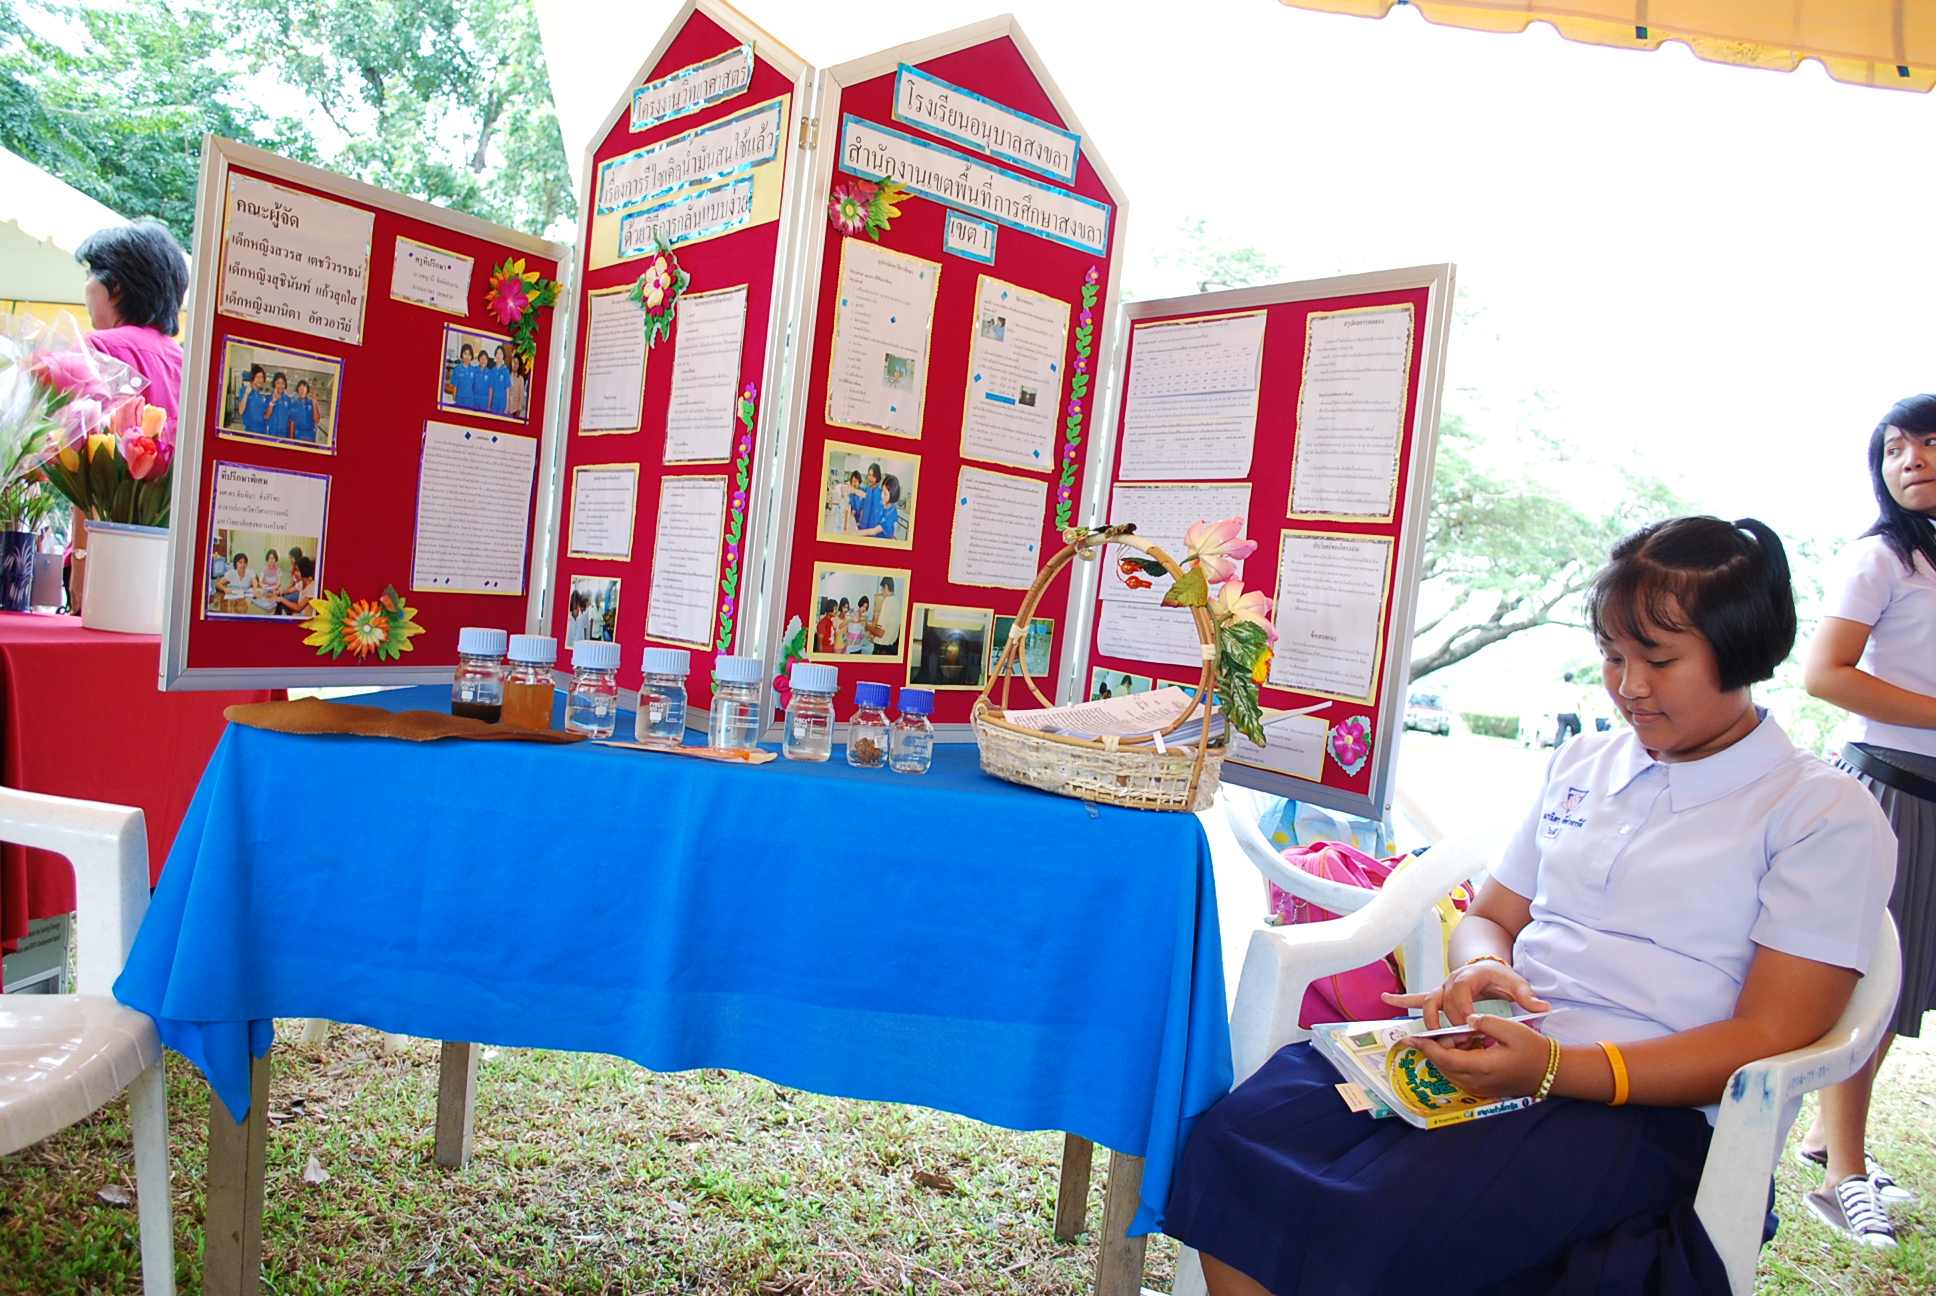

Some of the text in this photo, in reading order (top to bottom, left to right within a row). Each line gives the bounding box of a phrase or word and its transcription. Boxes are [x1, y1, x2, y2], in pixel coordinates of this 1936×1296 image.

[636, 57, 748, 120] โครงงานวิทยาศาสตร์
[906, 79, 1069, 172] โรงเรียนอนุบาลสงขลา
[603, 122, 775, 204] เรื่องการรีไซเคิลน้ำมันสนใช้แล้ว
[236, 198, 300, 229] คณะผู้จัด
[848, 137, 1103, 246] สำนักงานเขตพื้นที่การศึกษาสงขลา
[624, 191, 750, 247] ด้วยวิธีการกลั่นแบบง่าย
[949, 220, 989, 249] เขต 1
[231, 231, 303, 262] เด็กหญิงสวรส
[415, 254, 447, 271] ครูที่ปรึกษา
[228, 261, 358, 306] เด็กหญิงสุชินันท์ แก้วสุกใส
[225, 290, 353, 333] เด็กหญิงมานิตา อัศวอารีย์
[220, 467, 269, 486] ที่ปรึกษาพิเศษ
